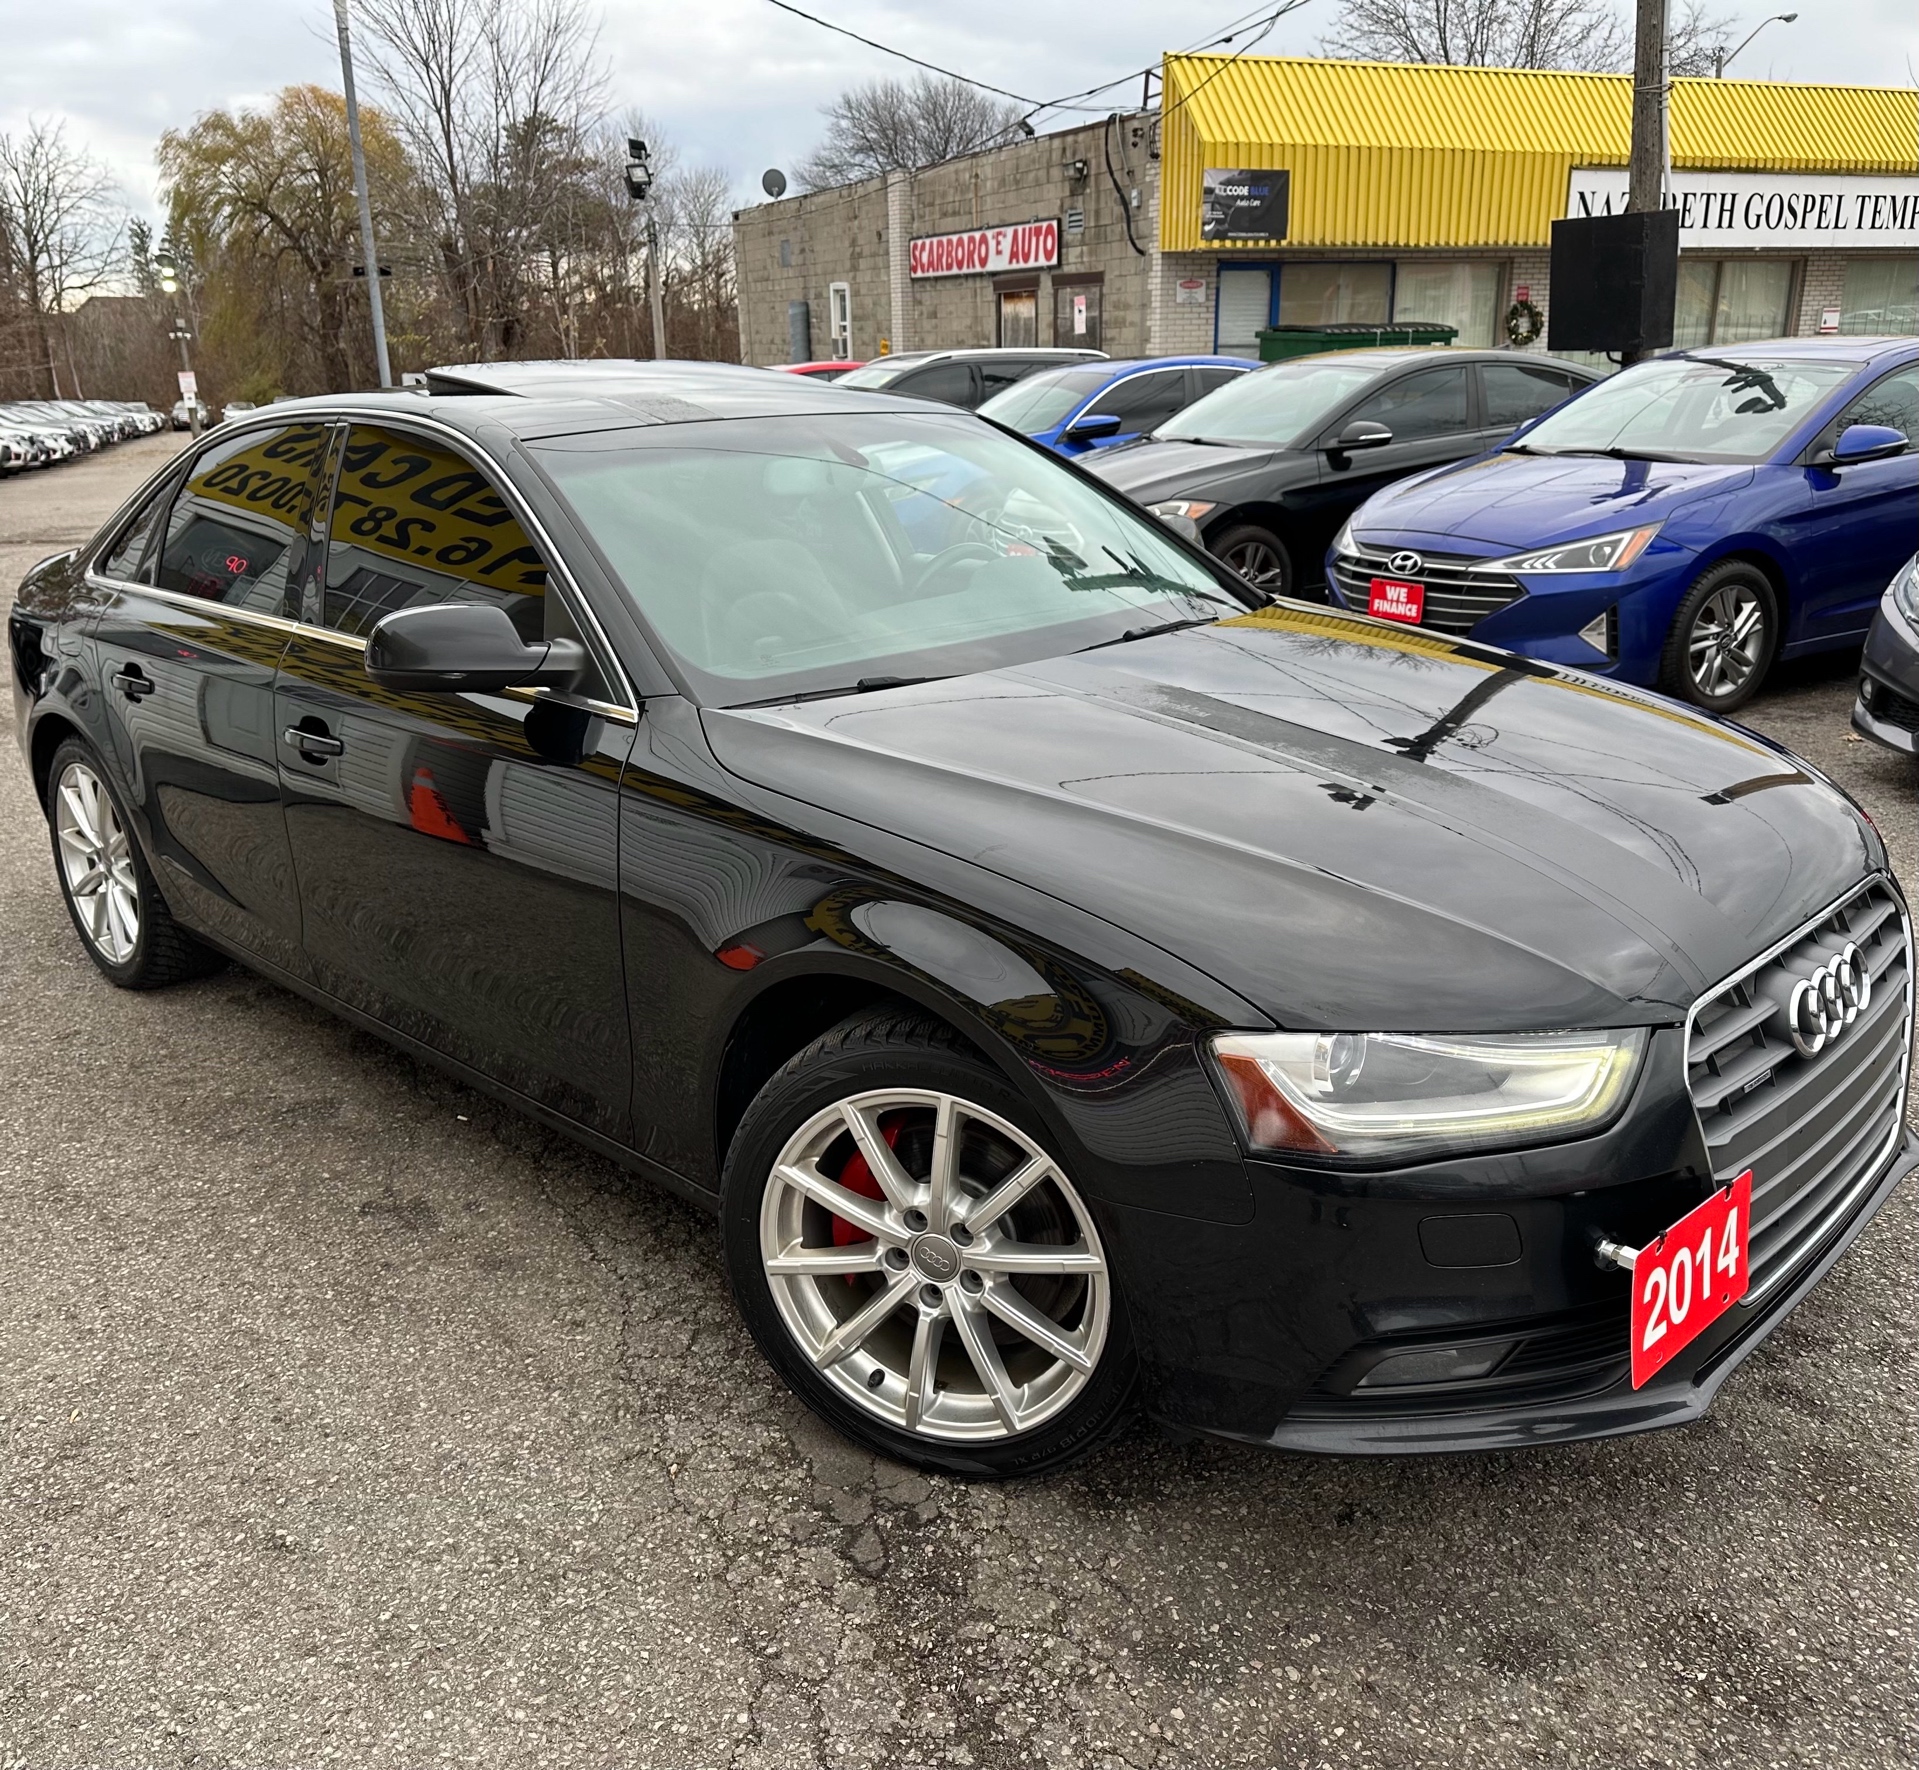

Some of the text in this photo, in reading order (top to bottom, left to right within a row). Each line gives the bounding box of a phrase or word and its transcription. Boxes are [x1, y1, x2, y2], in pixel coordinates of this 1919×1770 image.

[1227, 185, 1269, 196] CODE BLUE
[1744, 192, 1848, 230] GOSPEL
[911, 233, 989, 275] SCARBORO
[1009, 223, 1056, 265] AUTO
[1373, 598, 1419, 617] FINANCE
[1385, 585, 1409, 603] WE
[1643, 1206, 1740, 1351] 2014
